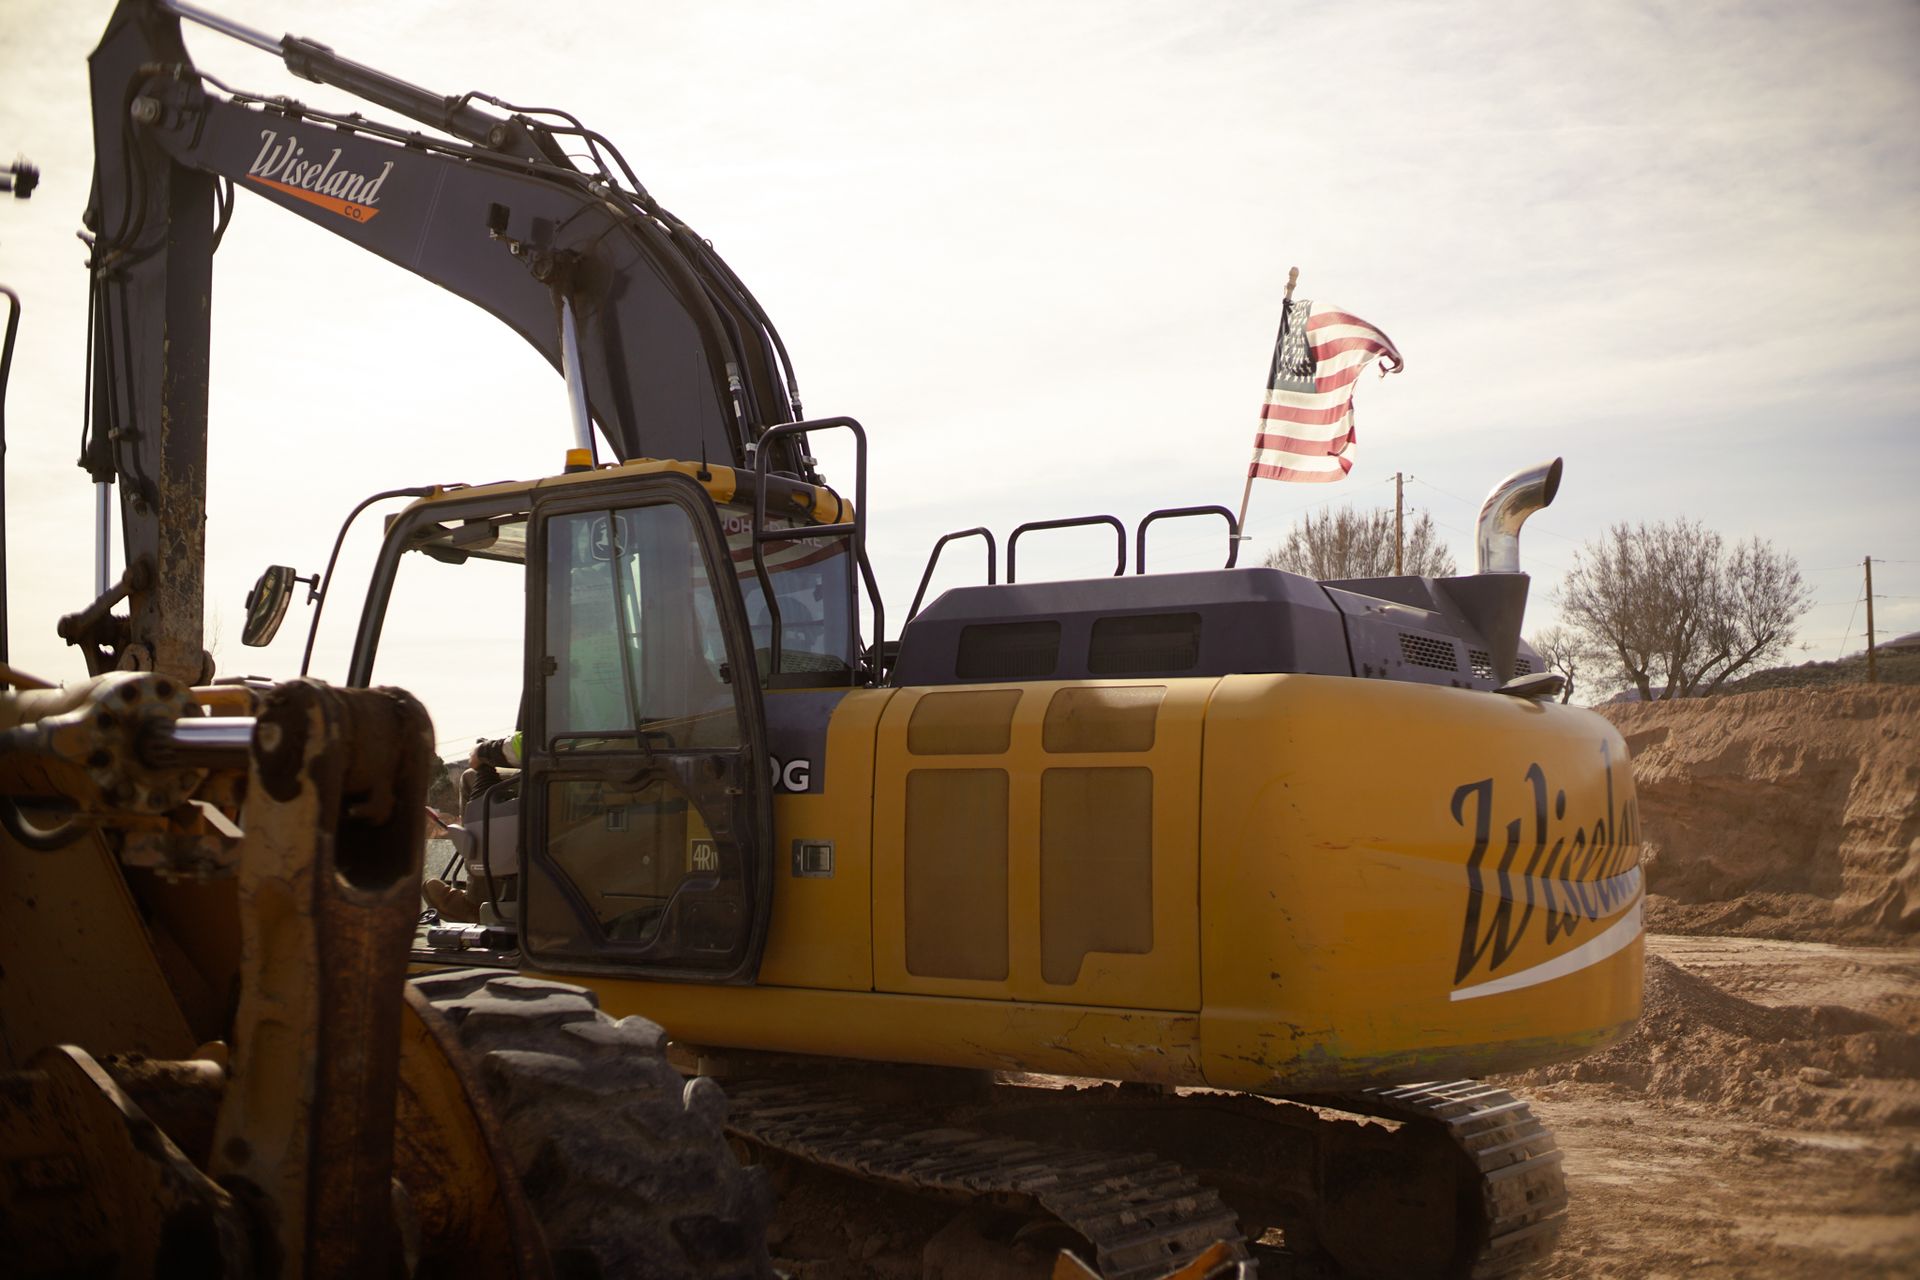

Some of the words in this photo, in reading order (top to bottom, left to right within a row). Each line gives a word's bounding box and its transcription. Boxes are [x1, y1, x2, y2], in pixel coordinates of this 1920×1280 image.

[249, 129, 394, 205] Wiseland
[344, 205, 364, 221] CO.
[722, 516, 754, 535] JOH
